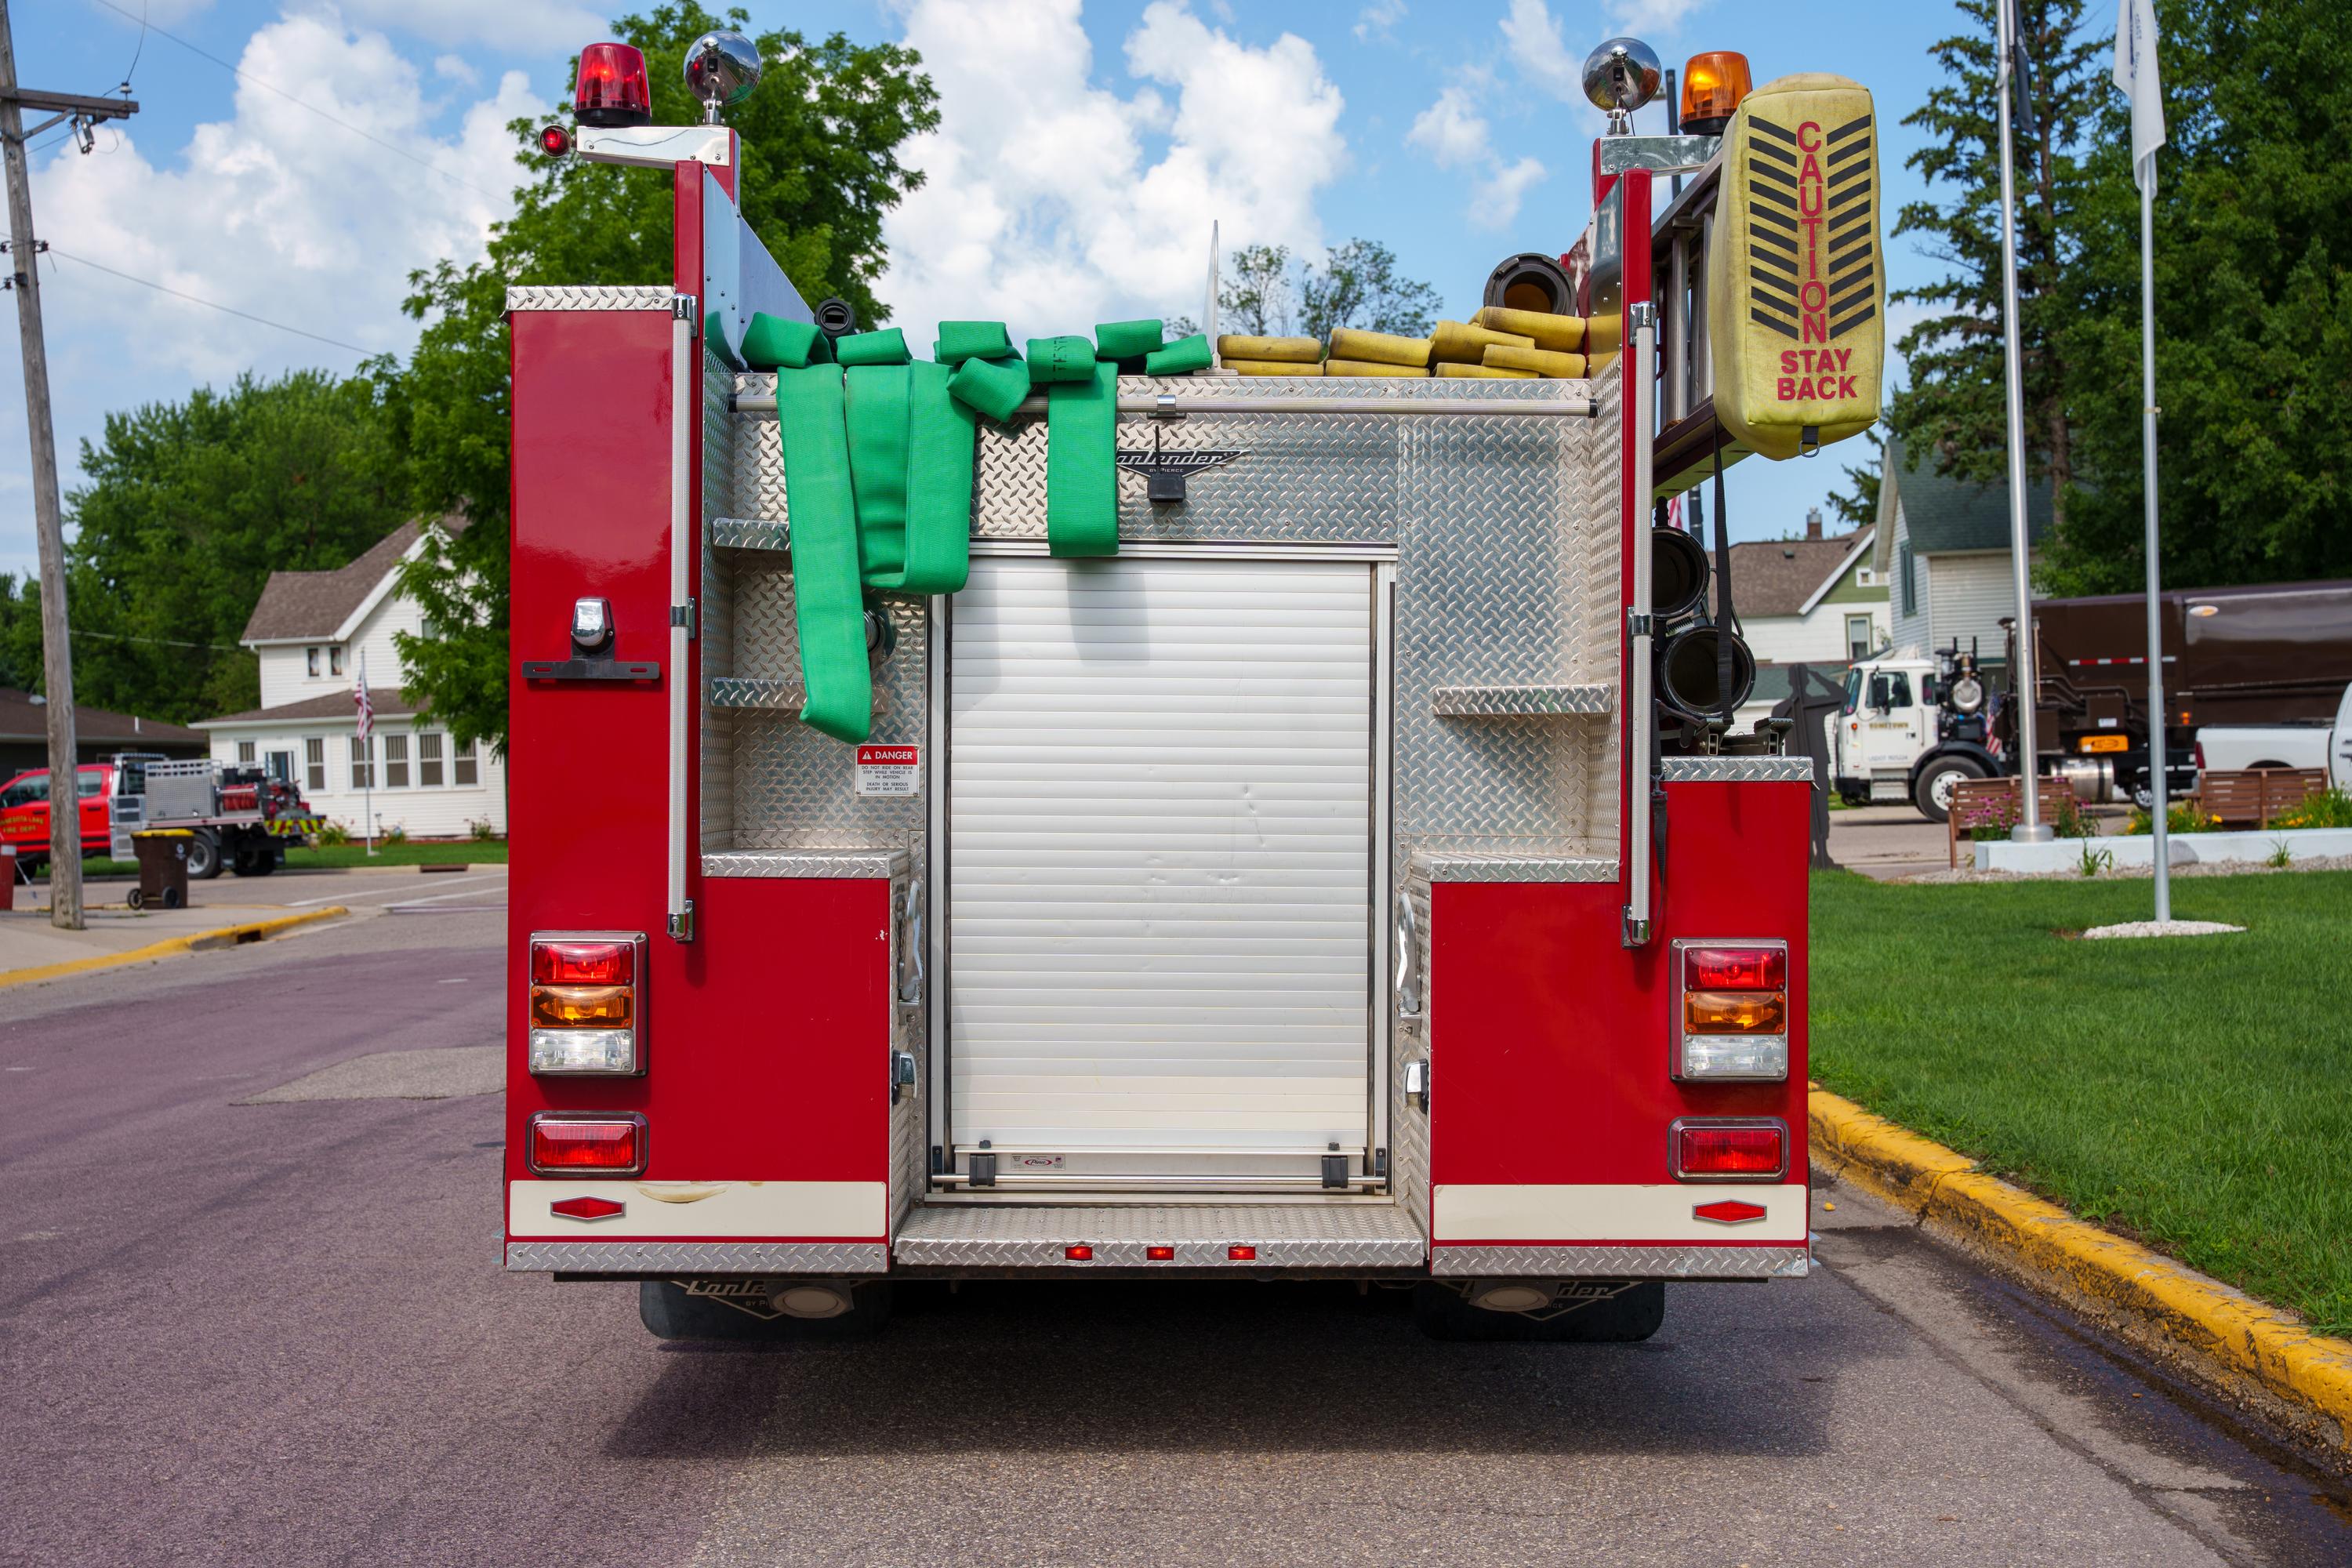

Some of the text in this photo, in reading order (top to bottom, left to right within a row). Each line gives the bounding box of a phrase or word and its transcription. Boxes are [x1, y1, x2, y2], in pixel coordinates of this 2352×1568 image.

[1797, 121, 1827, 343] CAUTION
[1780, 349, 1853, 374] STAY
[1777, 376, 1857, 401] BACK
[1116, 448, 1227, 465] ontender
[875, 751, 913, 760] DANGER
